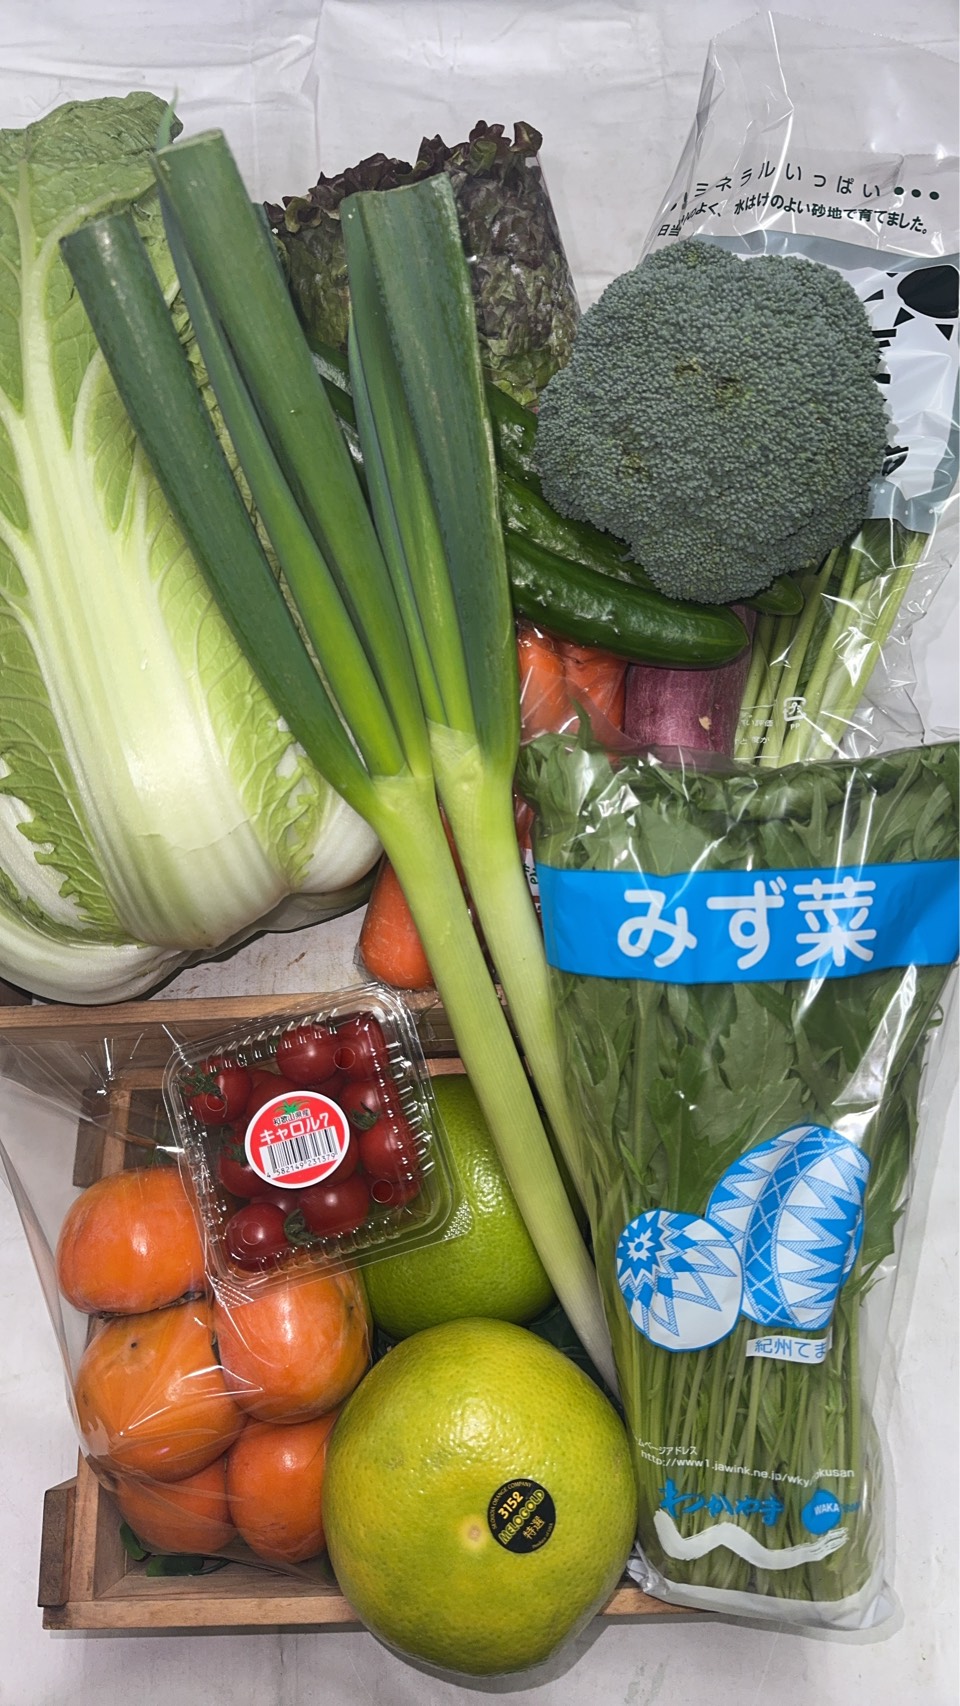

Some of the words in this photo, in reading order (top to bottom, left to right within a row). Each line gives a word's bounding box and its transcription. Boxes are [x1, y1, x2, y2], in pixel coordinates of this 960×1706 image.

[617, 876, 877, 970] みず菜
[260, 1112, 329, 1145] キャロル7
[273, 1108, 311, 1126] 和歌山県産
[498, 1491, 524, 1519] 3152
[813, 1502, 840, 1516] WAKA
